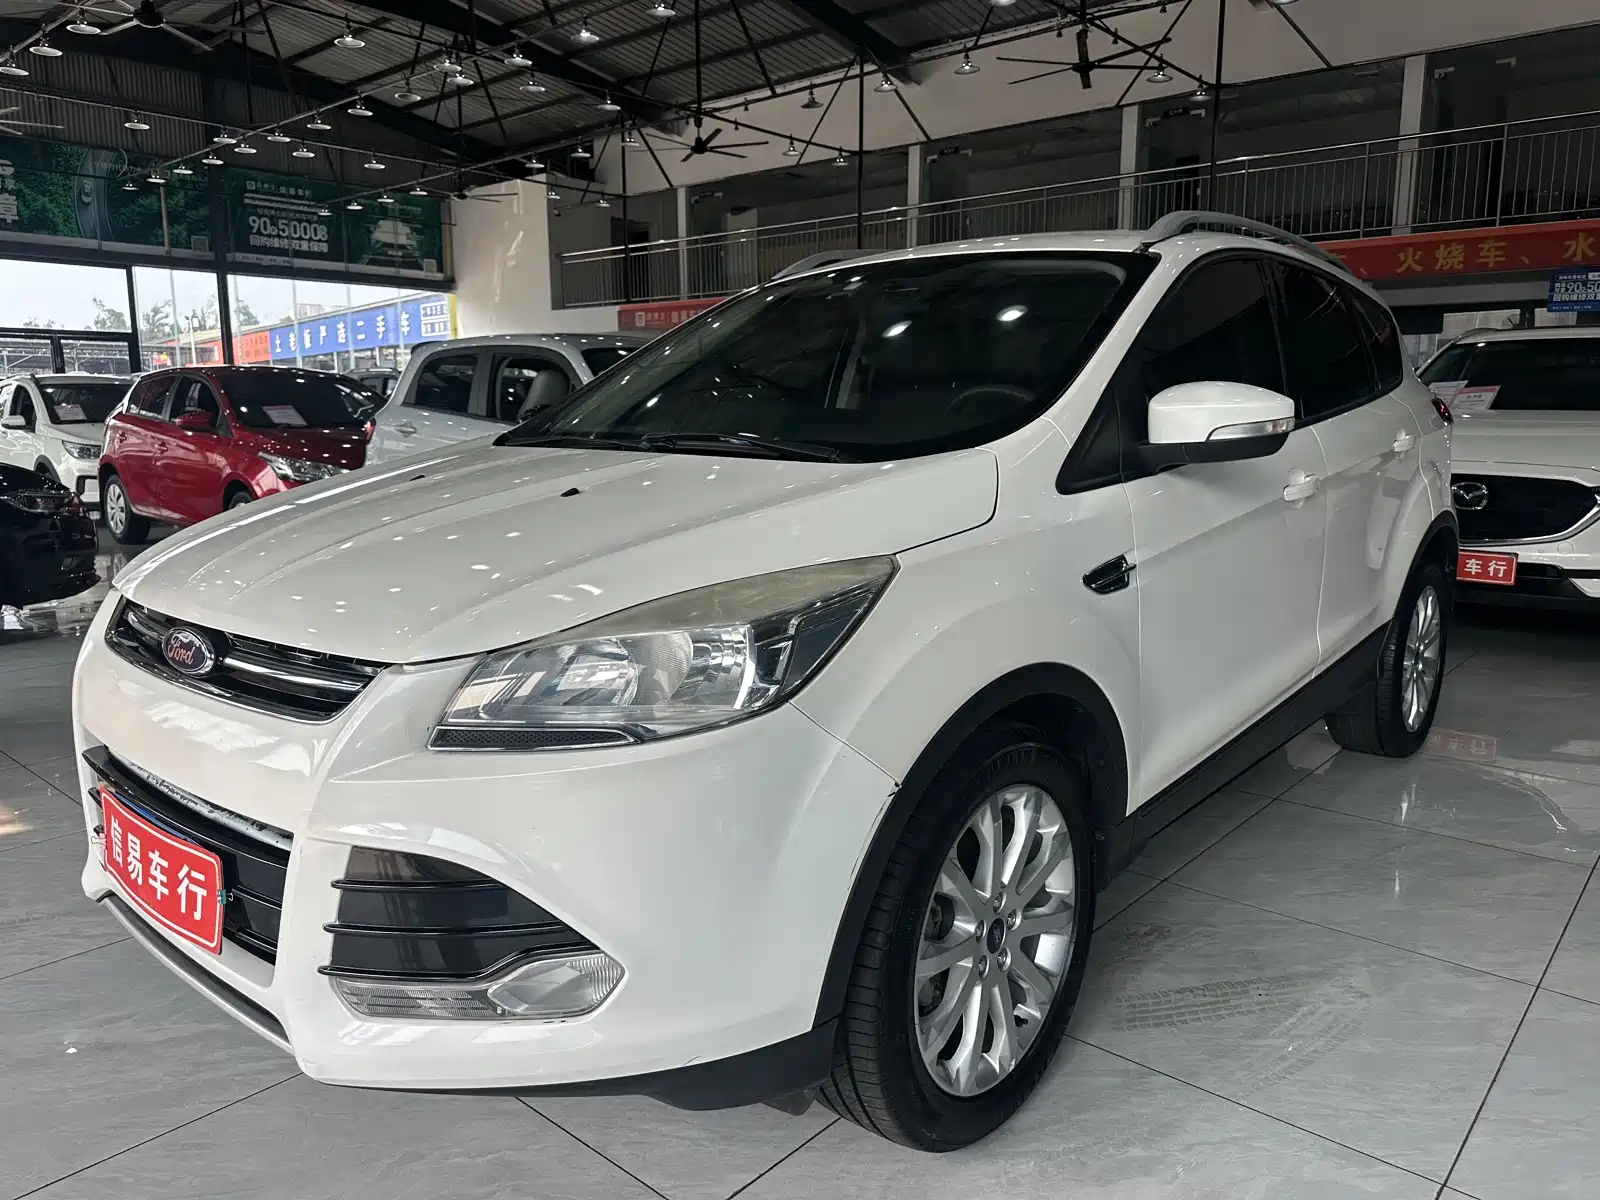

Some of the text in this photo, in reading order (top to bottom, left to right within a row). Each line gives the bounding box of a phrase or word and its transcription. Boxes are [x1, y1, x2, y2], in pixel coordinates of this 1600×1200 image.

[1331, 233, 1597, 277] 、火烧车、水
[1464, 559, 1508, 578] 车行
[167, 634, 196, 665] Ford
[110, 814, 208, 921] 信易车行
